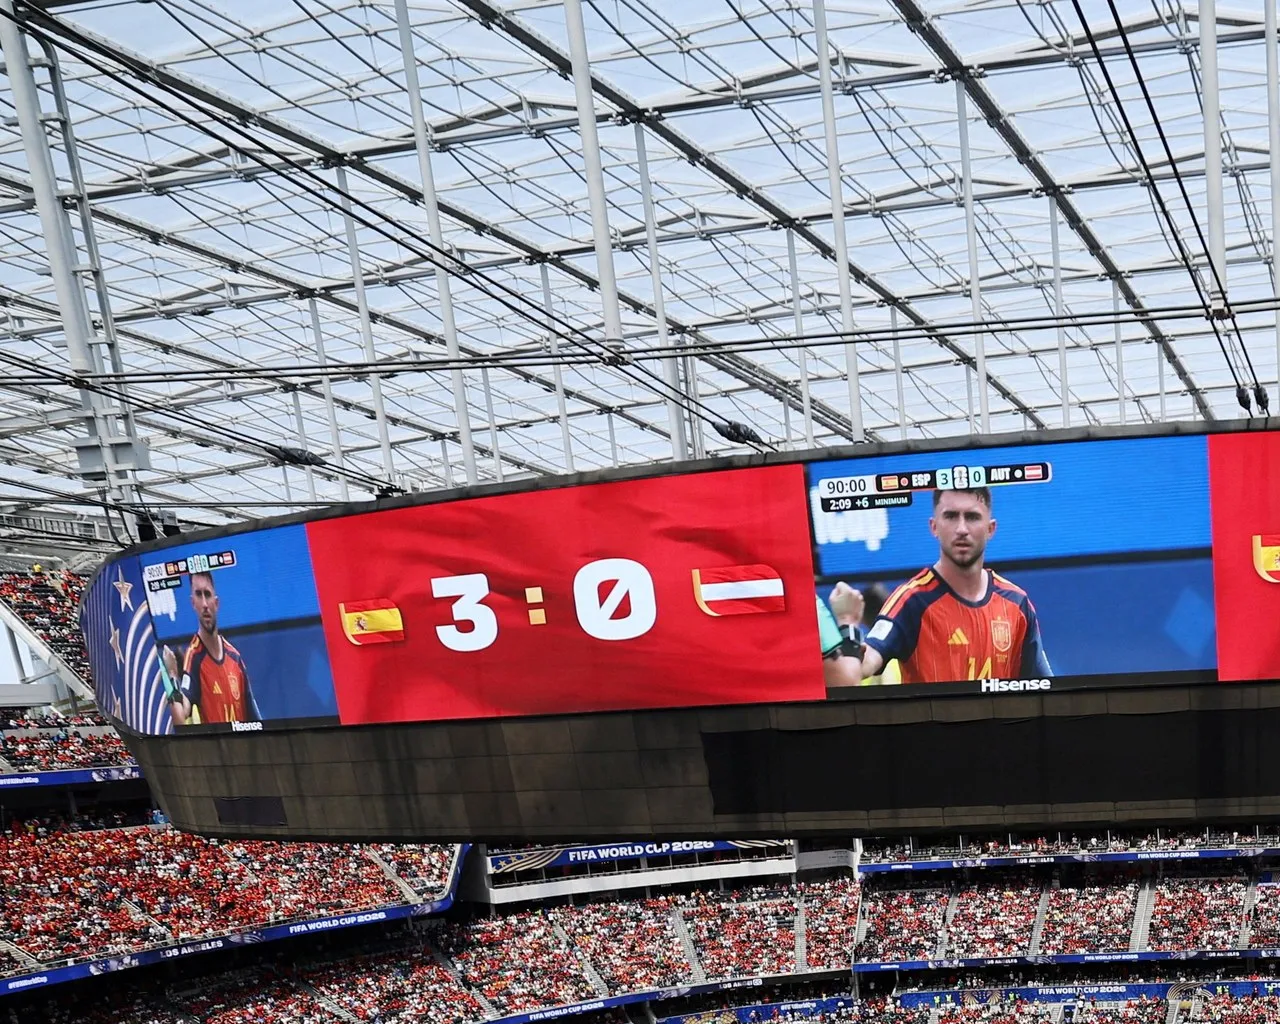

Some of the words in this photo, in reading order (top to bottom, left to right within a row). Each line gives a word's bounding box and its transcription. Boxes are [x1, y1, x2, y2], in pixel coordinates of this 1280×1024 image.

[827, 478, 866, 494] 90:00
[912, 473, 931, 487] ESP
[941, 472, 949, 485] 3
[973, 470, 981, 483] 0
[990, 467, 1011, 482] AUT
[830, 498, 851, 510] 2:09
[855, 498, 869, 509] +6
[875, 497, 908, 506] MINIMUM
[430, 572, 498, 652] 3
[573, 557, 657, 641] 0
[981, 678, 1051, 693] Hisense
[231, 721, 263, 732] Hisense
[569, 849, 597, 861] FIFA
[597, 844, 644, 859] WORLD
[645, 842, 671, 854] CUP
[672, 841, 714, 852] 2026
[289, 925, 307, 933] FIFA
[307, 917, 339, 930] WORLD
[340, 915, 357, 925] CUP
[160, 948, 179, 958] LOS
[181, 940, 223, 955] ANGELES
[1055, 987, 1083, 995] WORLD
[1084, 986, 1098, 994] CUP
